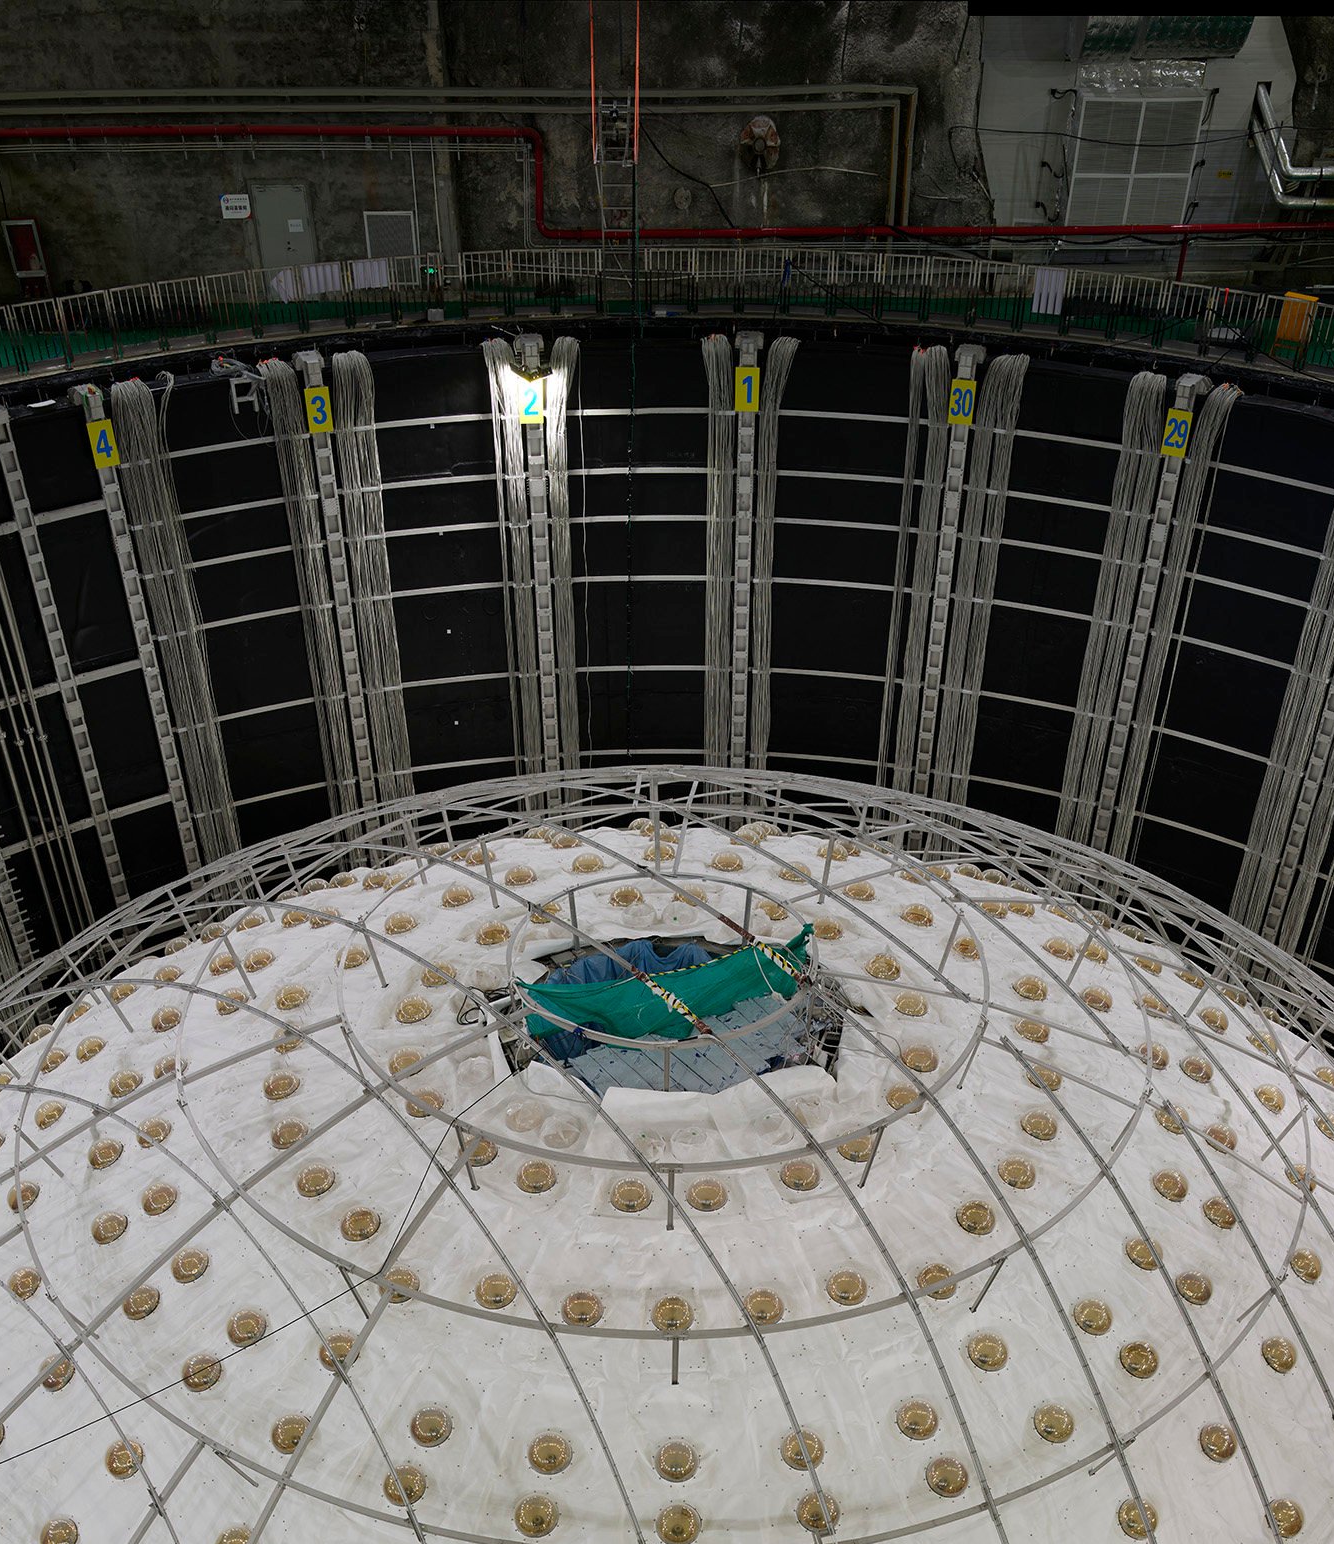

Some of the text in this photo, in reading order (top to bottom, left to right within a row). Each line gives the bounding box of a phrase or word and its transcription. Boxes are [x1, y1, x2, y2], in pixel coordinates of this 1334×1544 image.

[524, 387, 537, 415] 2
[742, 376, 752, 403] 1
[951, 388, 973, 416] 30
[311, 396, 327, 425] 3
[96, 430, 112, 458] 4
[1164, 418, 1189, 448] 29
